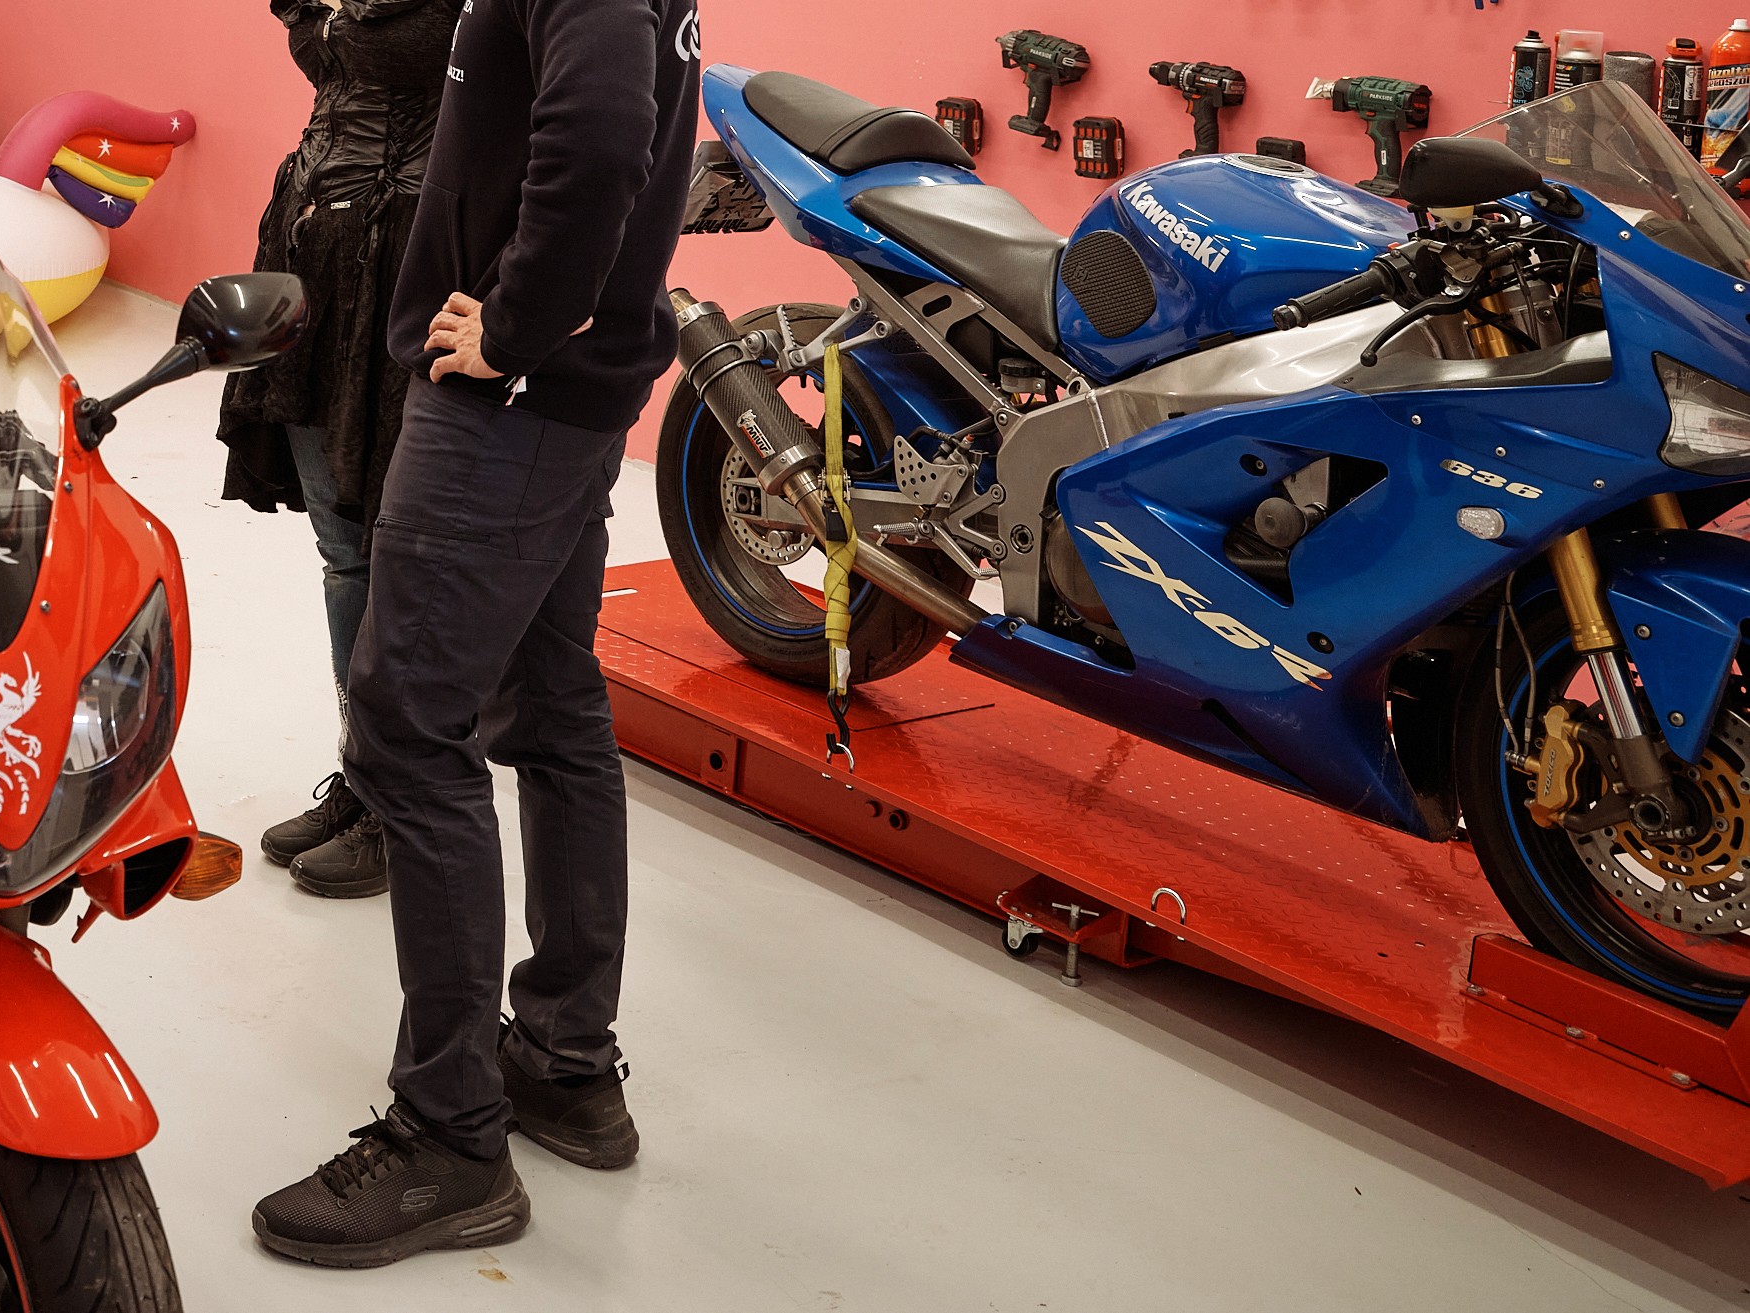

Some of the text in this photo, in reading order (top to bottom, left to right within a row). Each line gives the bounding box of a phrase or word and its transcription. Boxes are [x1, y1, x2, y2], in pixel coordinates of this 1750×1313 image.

[1029, 48, 1053, 59] PARKSIDE
[1369, 93, 1394, 102] PARKSIDE
[1124, 181, 1231, 274] Kawasaki
[1439, 458, 1544, 499] 636
[1543, 749, 1556, 797] TOKICO
